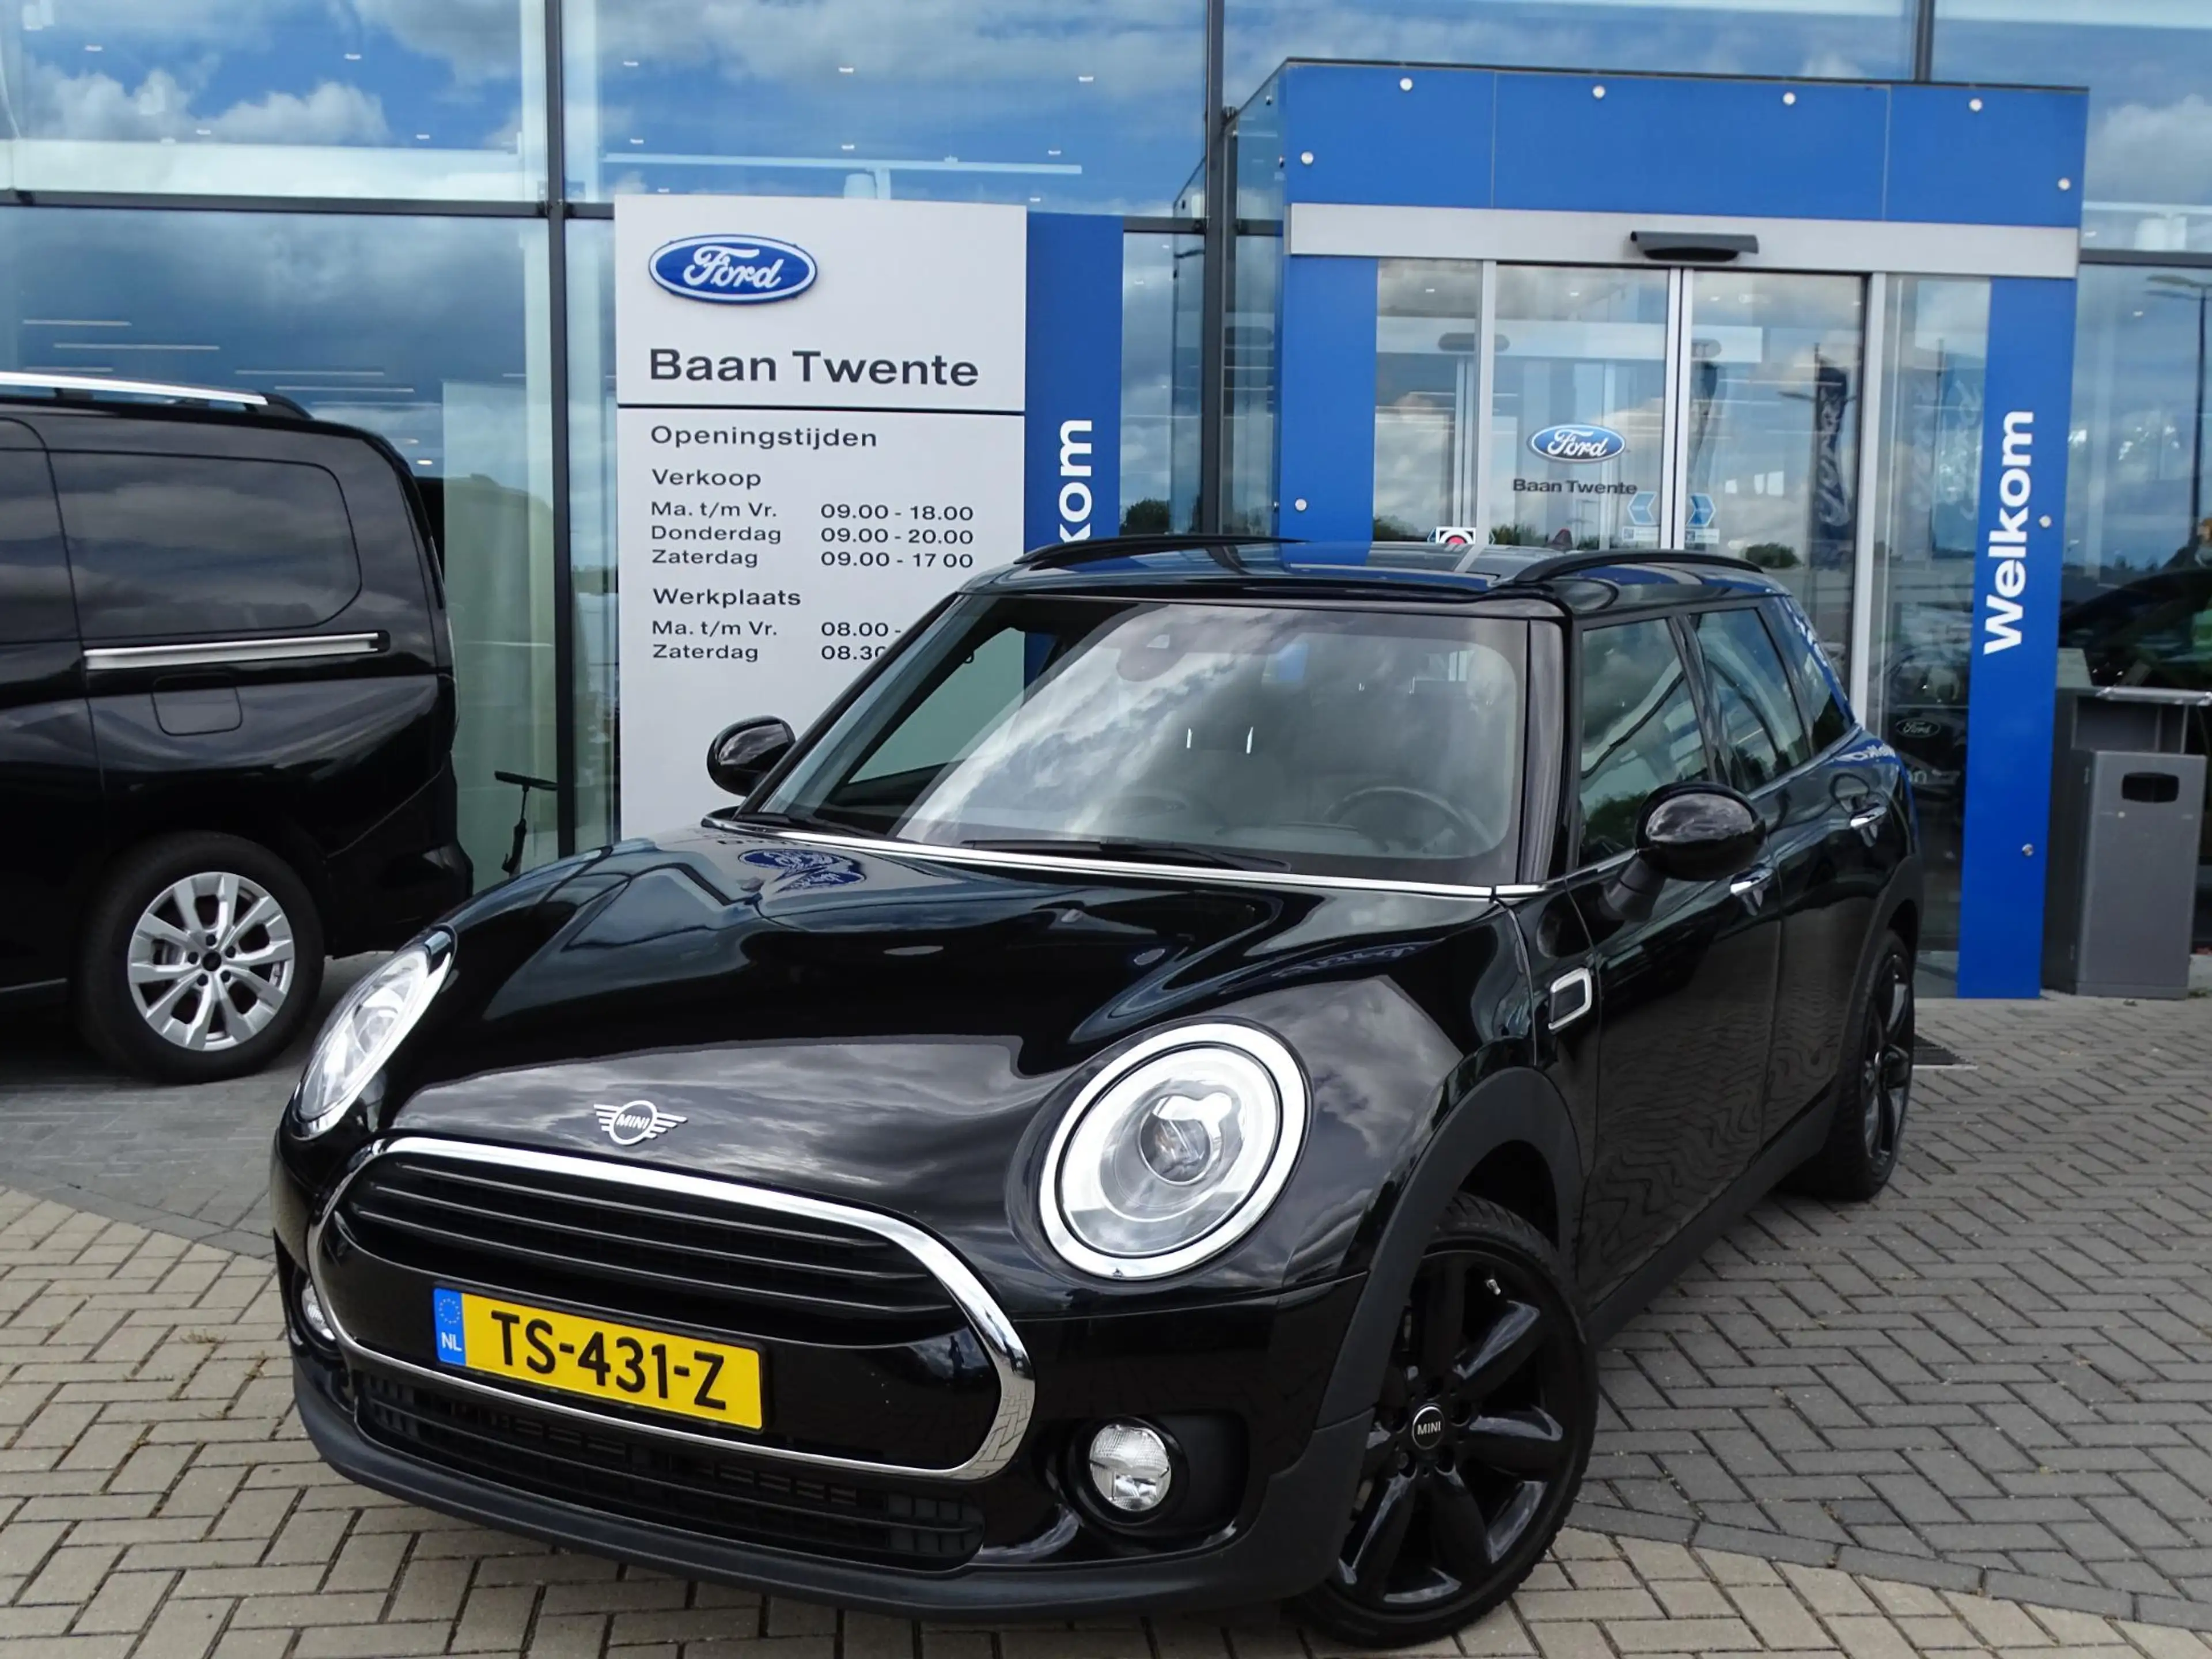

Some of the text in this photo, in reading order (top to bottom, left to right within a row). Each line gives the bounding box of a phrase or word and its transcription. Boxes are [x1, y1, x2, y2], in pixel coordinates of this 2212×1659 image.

[683, 245, 784, 288] Ford
[650, 348, 979, 387] Baan Twente
[651, 425, 877, 450] Openingstijden
[1547, 429, 1609, 457] Ford
[652, 468, 762, 490] Verkoop
[1513, 478, 1638, 495] Baan Twente
[652, 501, 692, 516] Ma.
[700, 502, 740, 518] t/m
[748, 502, 777, 517] Vr.
[820, 503, 889, 520] 09.00
[910, 505, 974, 521] 18.00
[652, 525, 781, 545] Donderdag
[821, 527, 889, 543] 09.00
[908, 529, 974, 545] 20.00
[1983, 411, 2034, 655] Welkom
[652, 549, 757, 569] Zaterdag
[821, 551, 890, 567] 09.00
[653, 588, 801, 609] Werkplaats
[652, 620, 694, 635] Ma.
[700, 620, 741, 638] t/m
[748, 621, 777, 636] Vr.
[821, 622, 889, 637] 08.00
[653, 644, 758, 663] Zaterdag
[1902, 721, 1932, 734] Ford
[616, 1113, 651, 1130] MINI
[441, 1331, 462, 1351] NL
[491, 1309, 726, 1411] TS-431-Z
[1417, 1421, 1441, 1435] MINI
